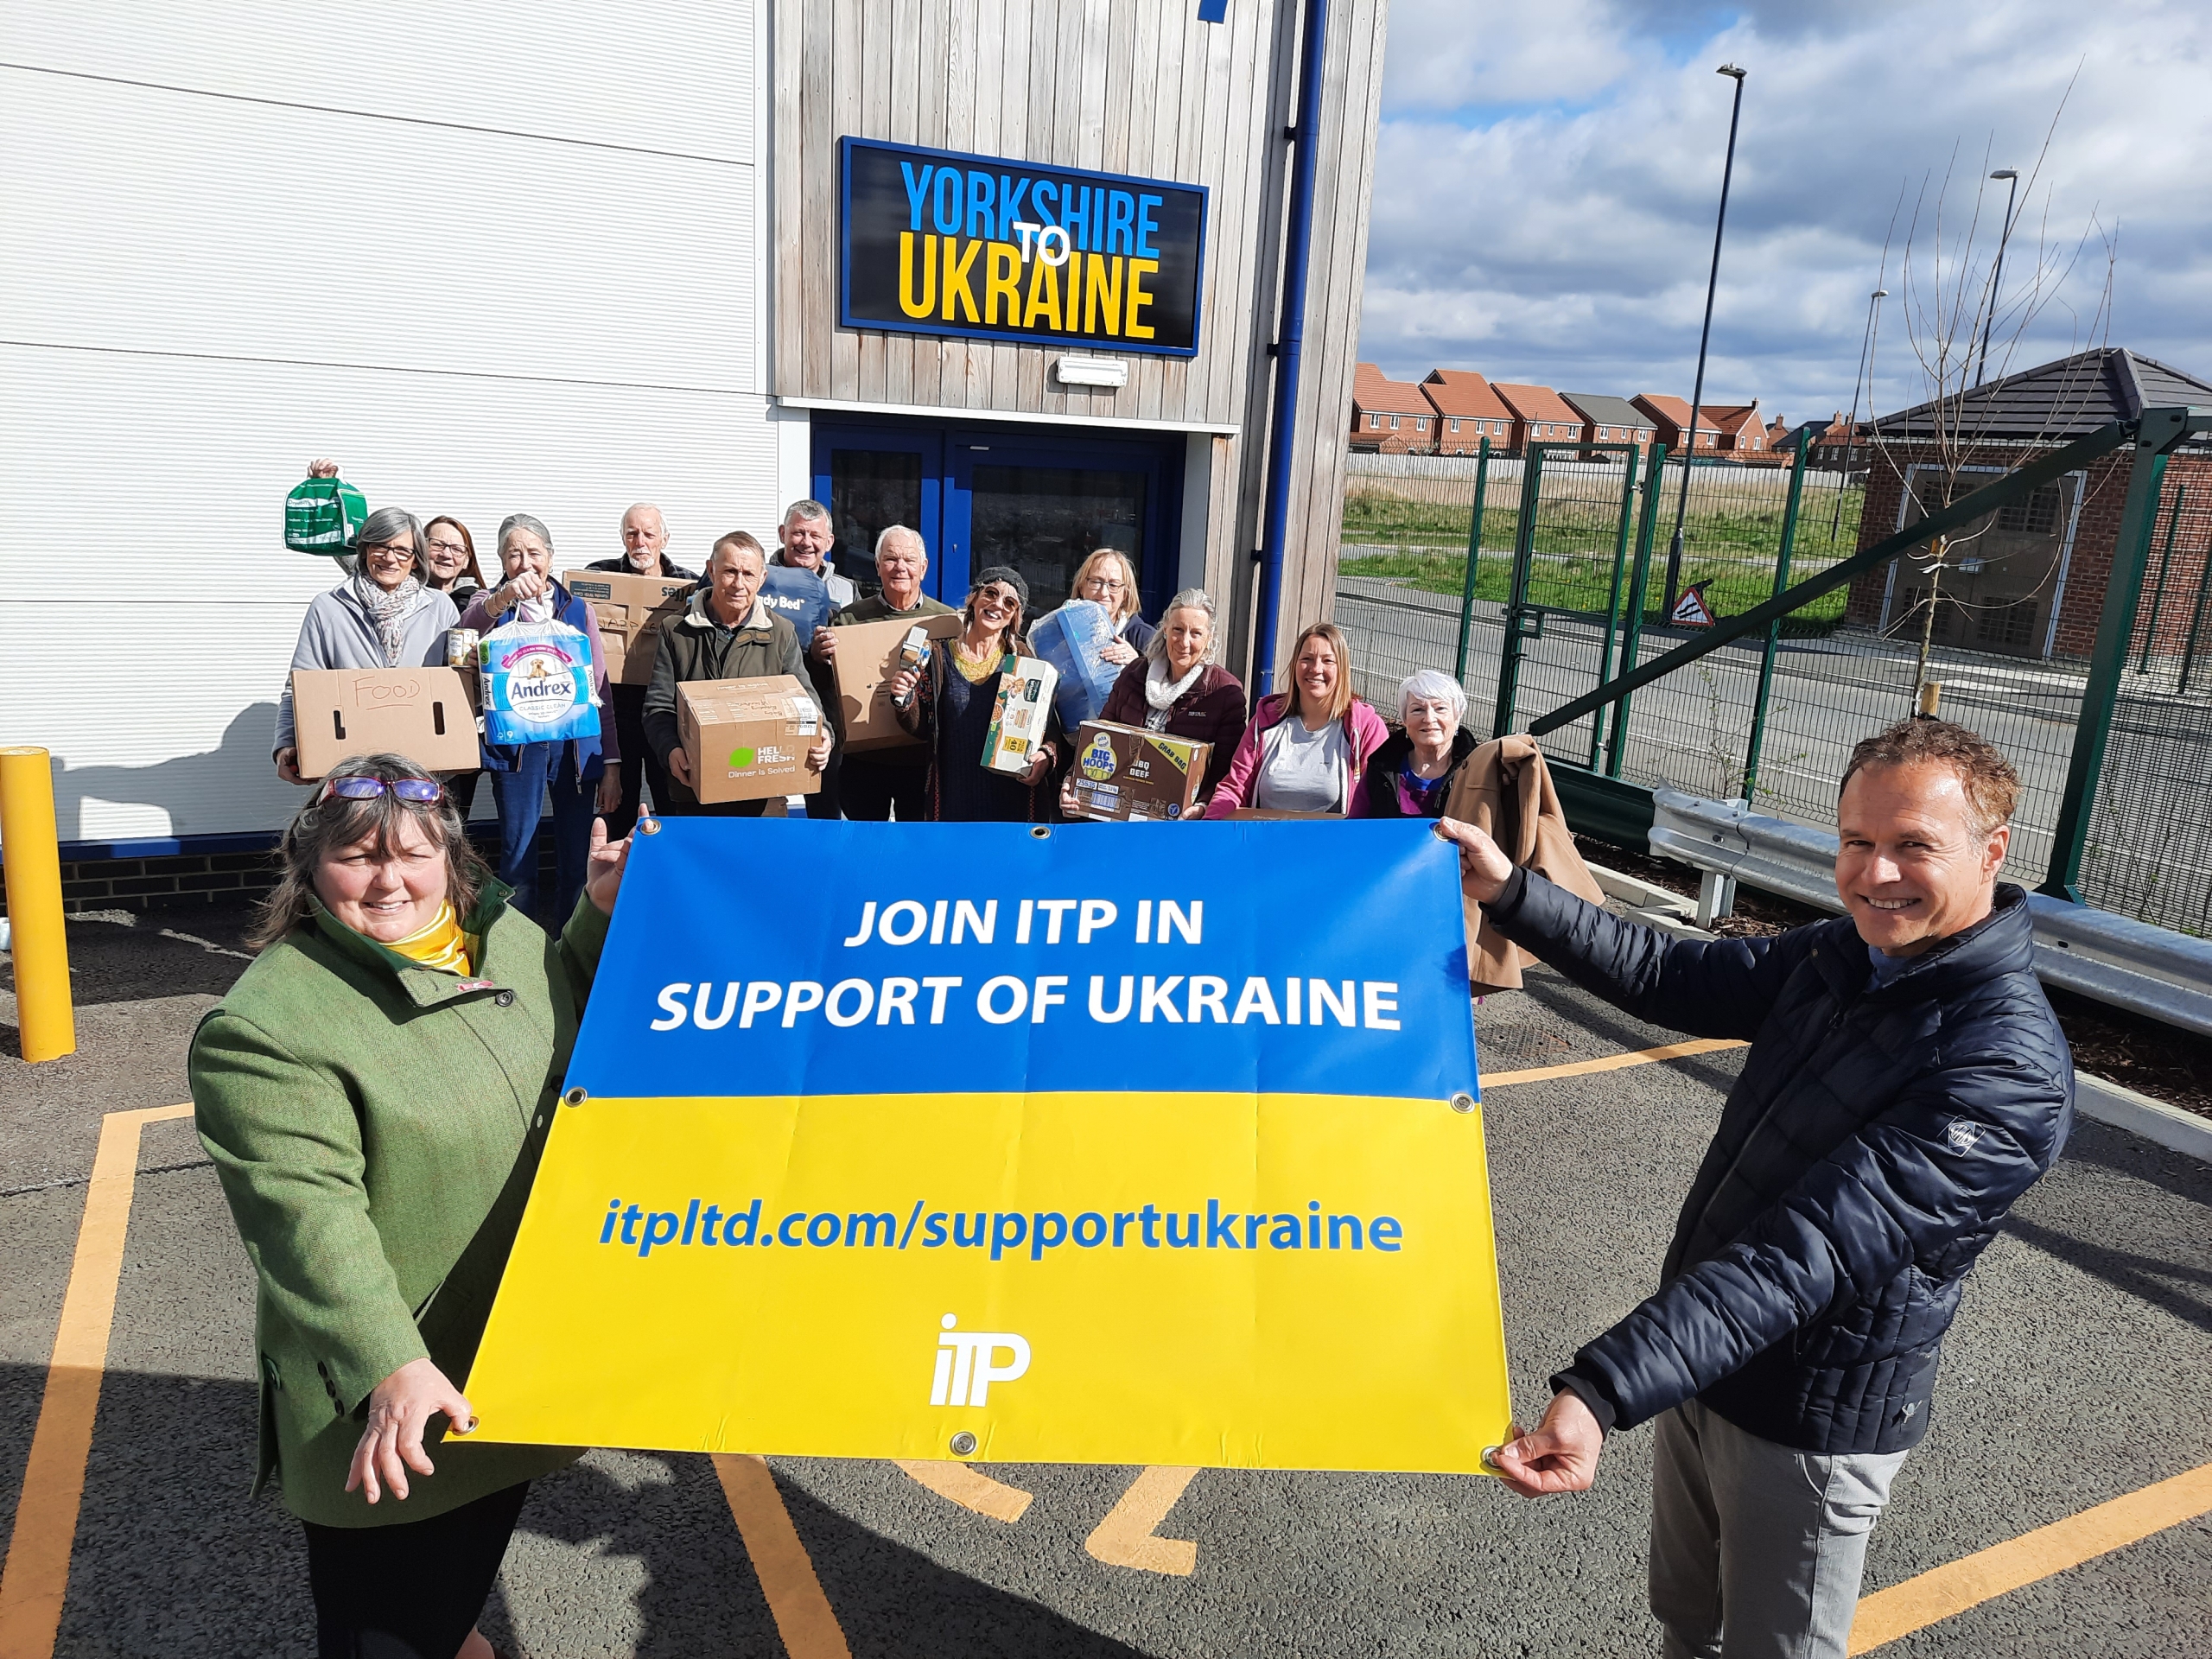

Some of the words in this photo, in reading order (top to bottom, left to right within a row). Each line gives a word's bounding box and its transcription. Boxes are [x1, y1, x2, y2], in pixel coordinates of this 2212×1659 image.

[900, 161, 1163, 259] YORKSHIRE
[1013, 221, 1071, 267] TO
[899, 231, 1159, 340] UKRAINE
[352, 677, 421, 707] FOOD
[511, 680, 571, 700] Andrex
[757, 753, 796, 765] FRESH
[1009, 739, 1017, 751] 40
[1091, 748, 1110, 761] BIG
[1158, 742, 1175, 758] GRAB
[1173, 755, 1186, 770] BAG
[728, 770, 757, 779] Dinner
[767, 764, 796, 775] Solved
[1083, 757, 1115, 772] HOOPS
[1129, 767, 1149, 779] BEEF
[844, 899, 998, 947] JOIN
[1015, 899, 1118, 944] ITP
[1135, 899, 1203, 944] IN
[650, 976, 963, 1031] SUPPORT
[976, 975, 1069, 1024] OF
[1088, 975, 1401, 1031] UKRAINE
[600, 1198, 1403, 1261] itpltd.com/supportukraine
